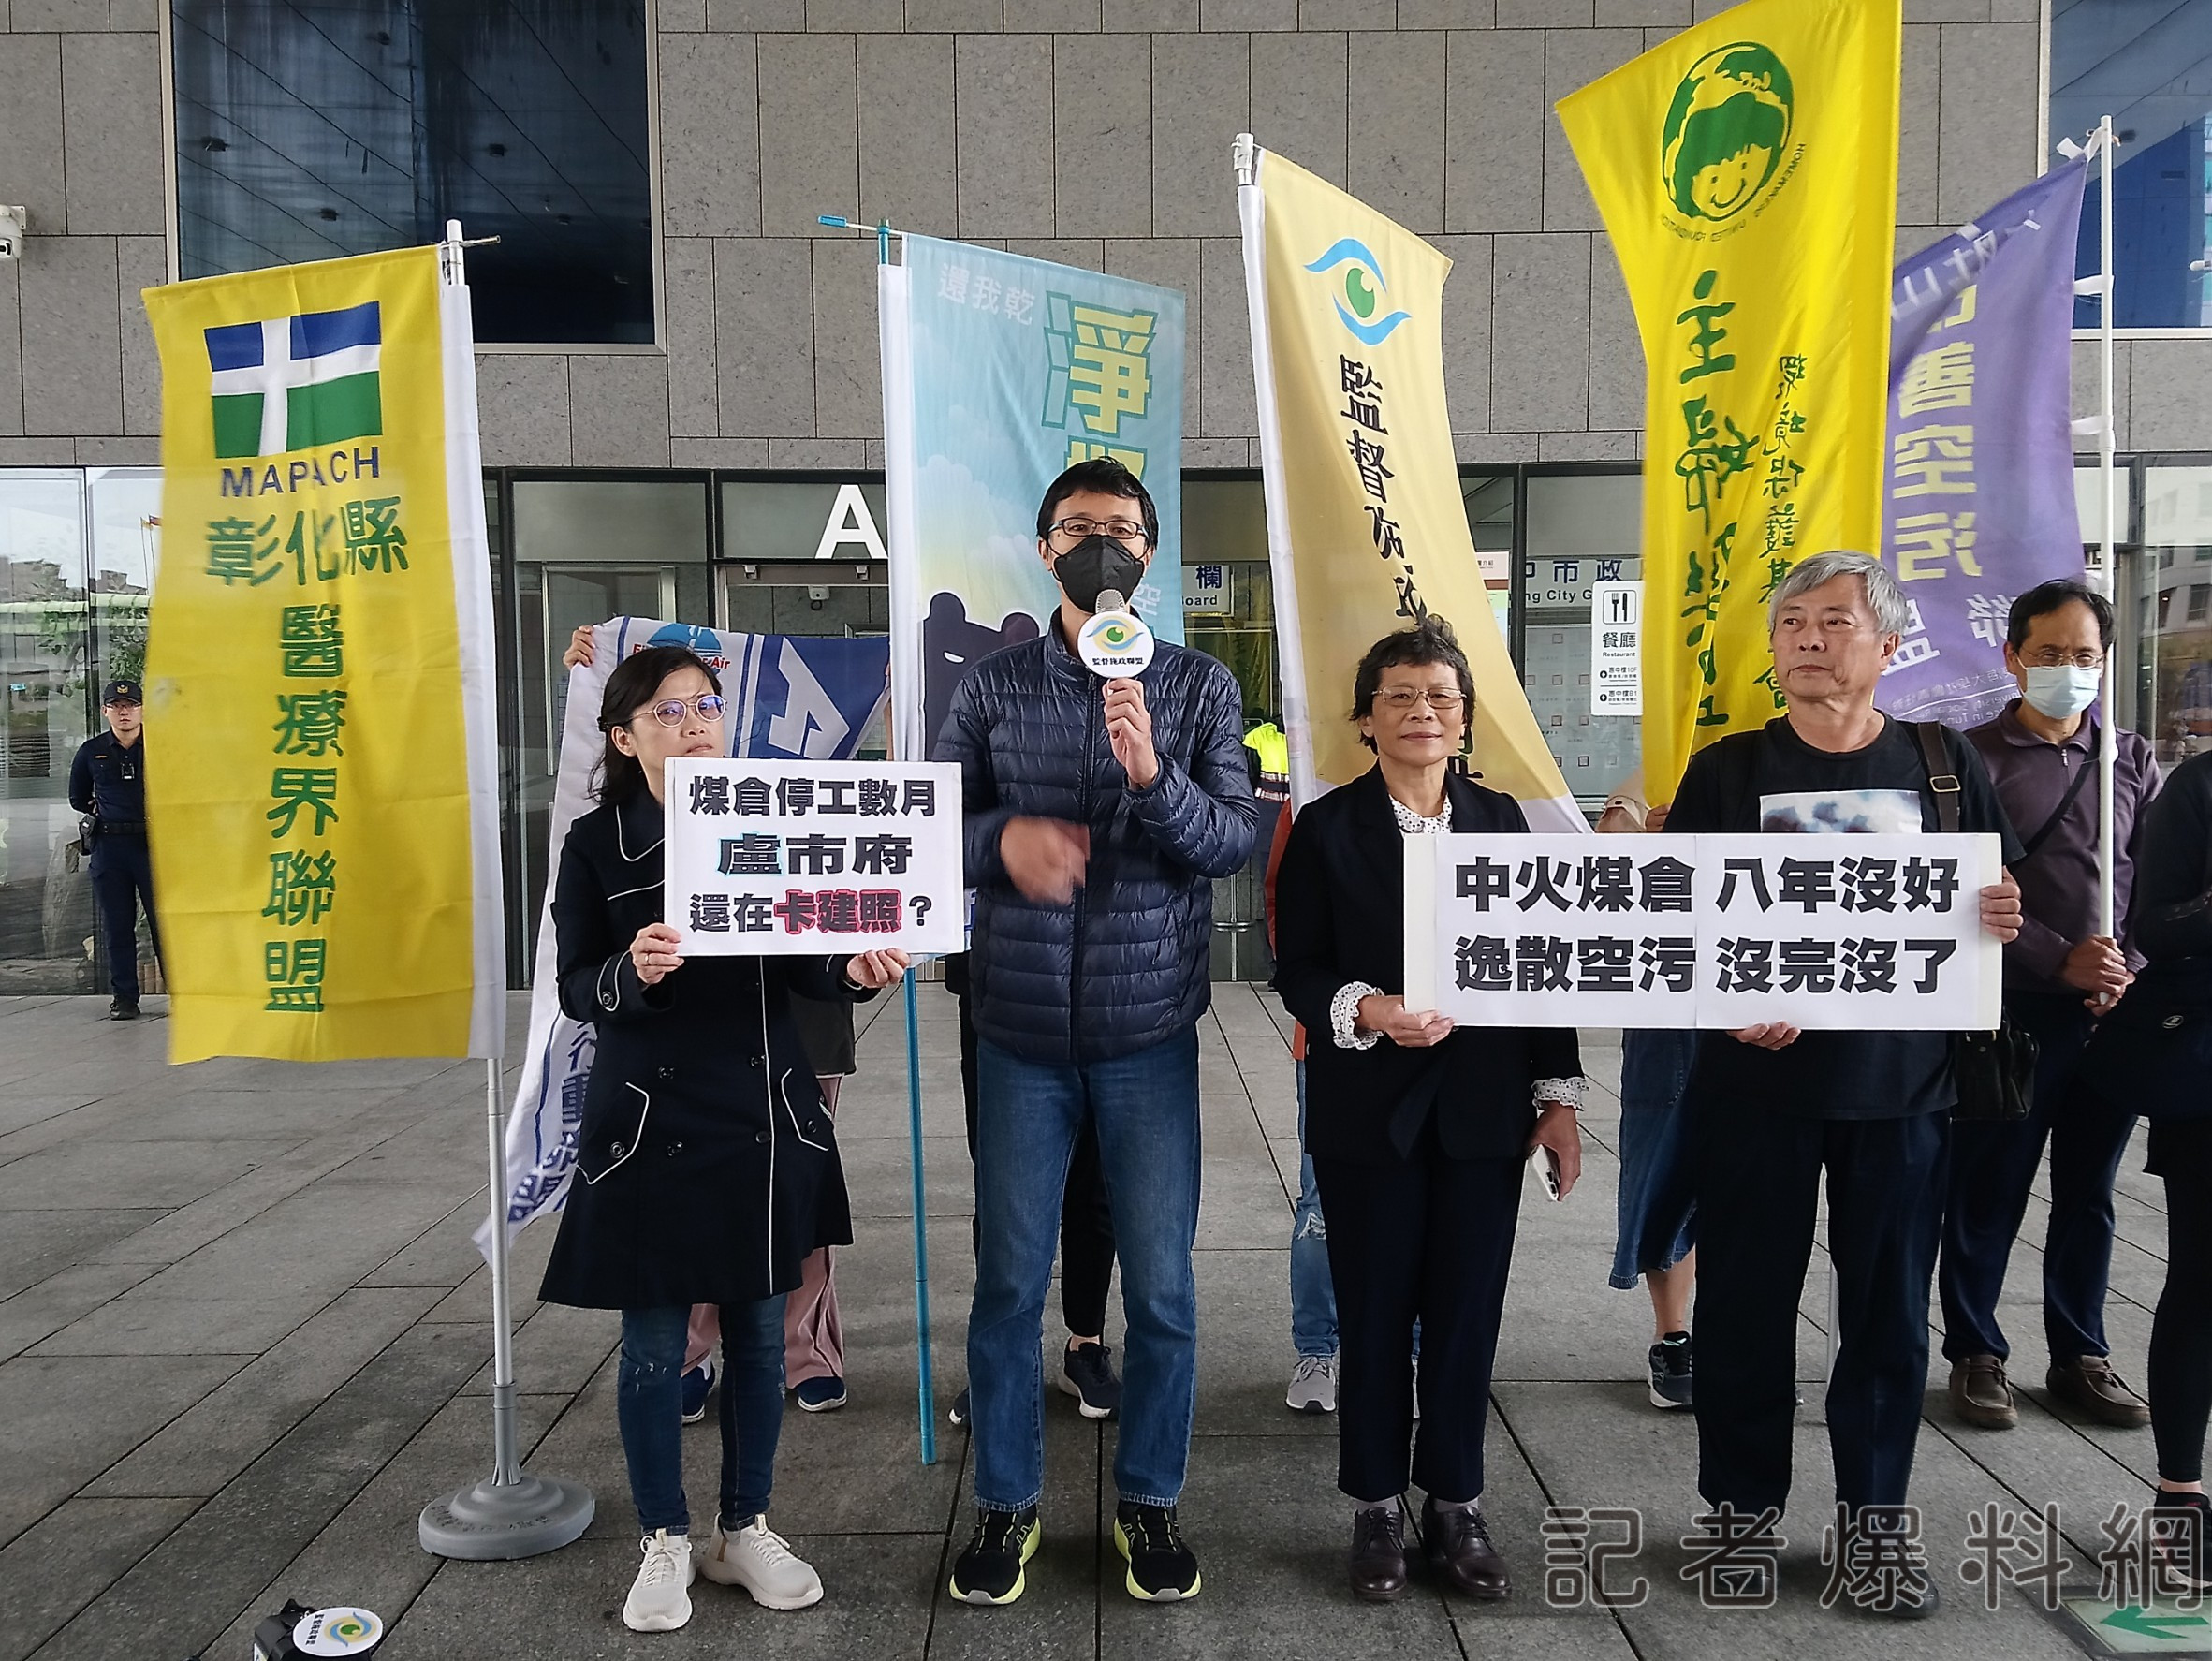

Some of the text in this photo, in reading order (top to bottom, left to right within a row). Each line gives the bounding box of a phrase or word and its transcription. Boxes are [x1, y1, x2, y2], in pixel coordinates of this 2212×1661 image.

[937, 261, 1036, 326] 還我乾
[221, 445, 379, 498] MAPACH
[205, 495, 408, 588] 彰化縣
[813, 483, 888, 559] A
[1195, 565, 1223, 590] 欄
[1546, 589, 1576, 603] City
[1181, 595, 1218, 606] oard
[710, 657, 731, 669] Air
[1602, 632, 1637, 649] 餐廳
[261, 602, 348, 1014] 醫療界聯盟
[688, 775, 936, 817] 煤倉停工數月
[717, 832, 913, 876] 盧市府
[1454, 854, 1959, 915] 中火煤倉 八年沒好
[688, 889, 934, 934] 還在卡建照？
[1454, 934, 1958, 994] 逸散空污 沒完沒了
